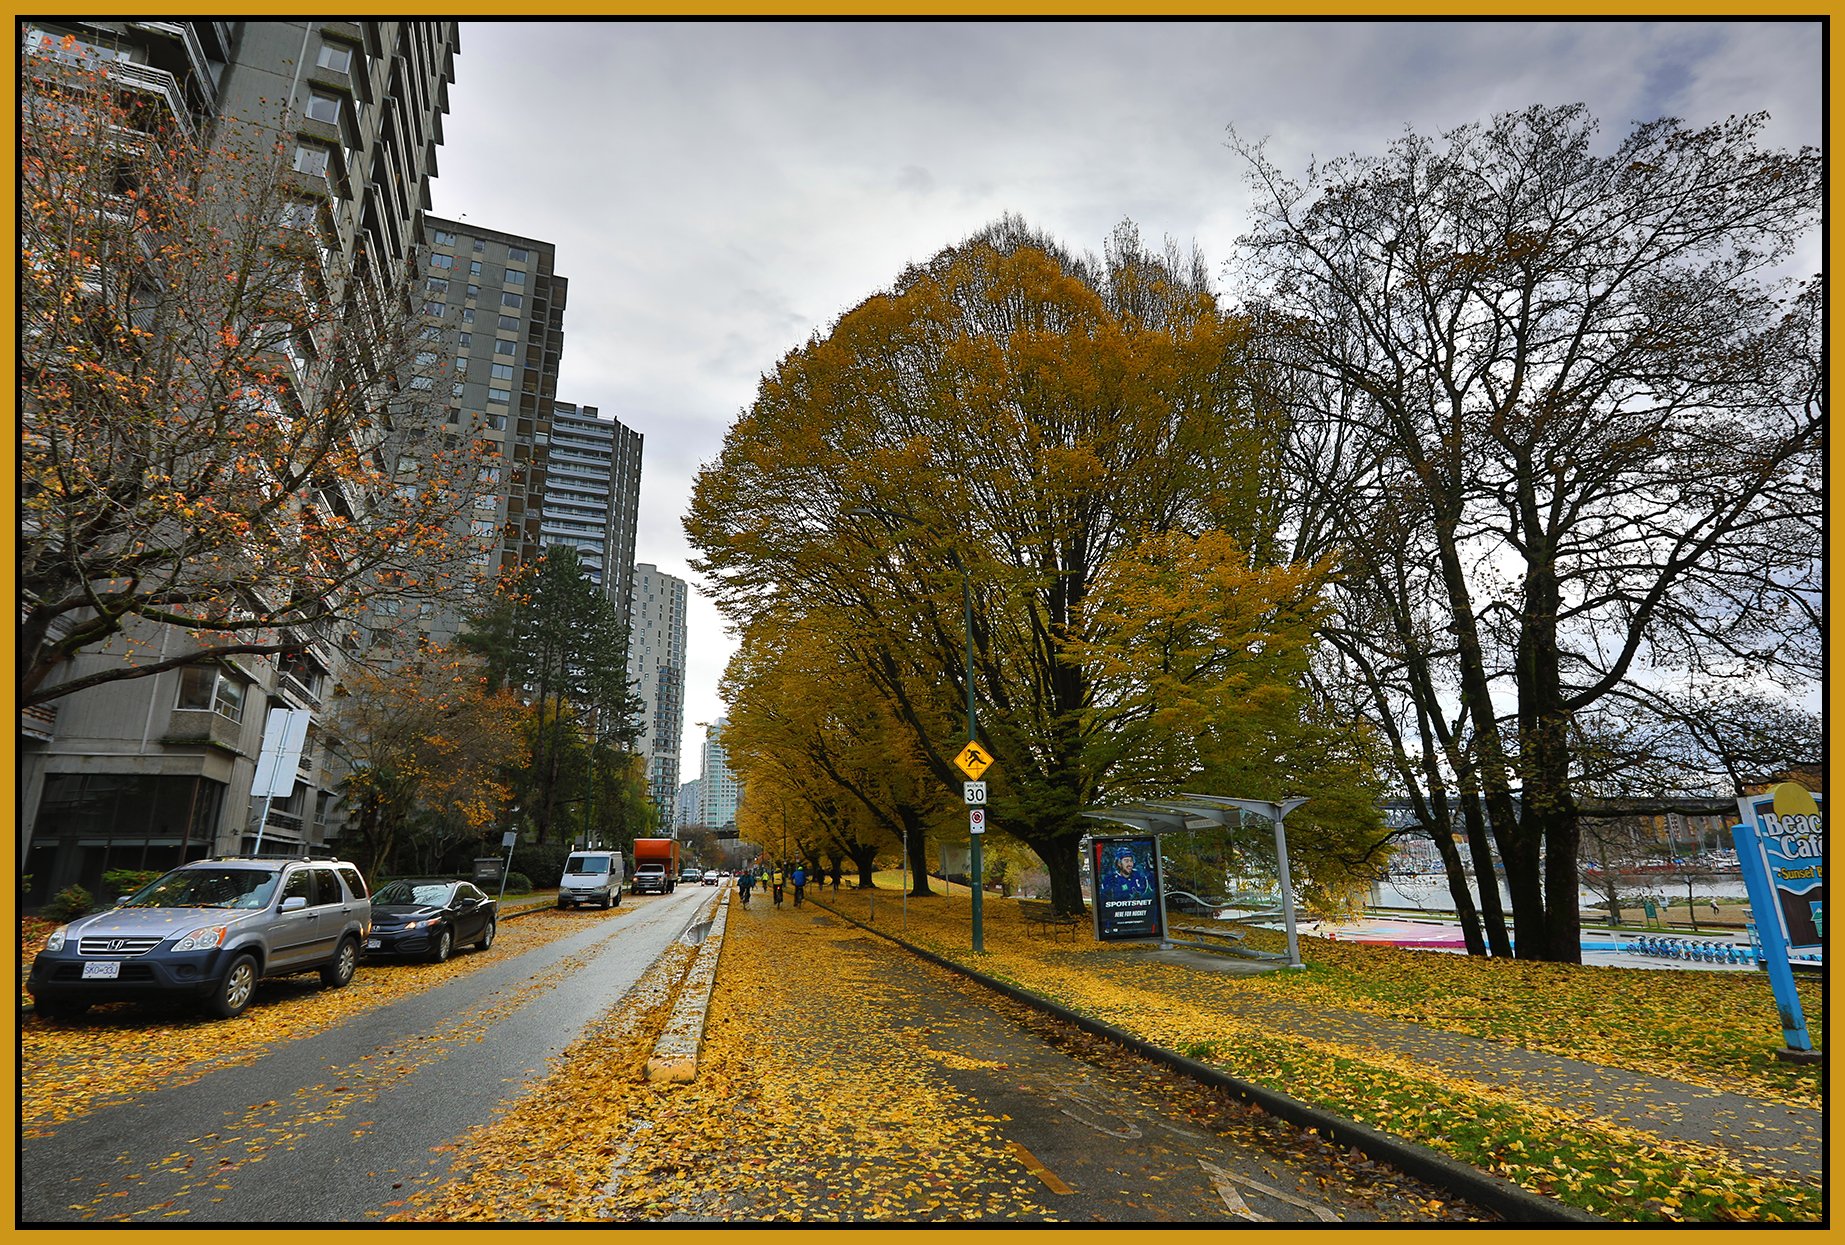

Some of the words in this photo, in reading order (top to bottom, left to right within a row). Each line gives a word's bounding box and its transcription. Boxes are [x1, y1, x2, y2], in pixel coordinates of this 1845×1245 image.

[967, 789, 984, 802] 30
[1763, 812, 1822, 836] Beac
[1781, 866, 1815, 880] Sunset
[1105, 899, 1152, 908] SPORTSNET
